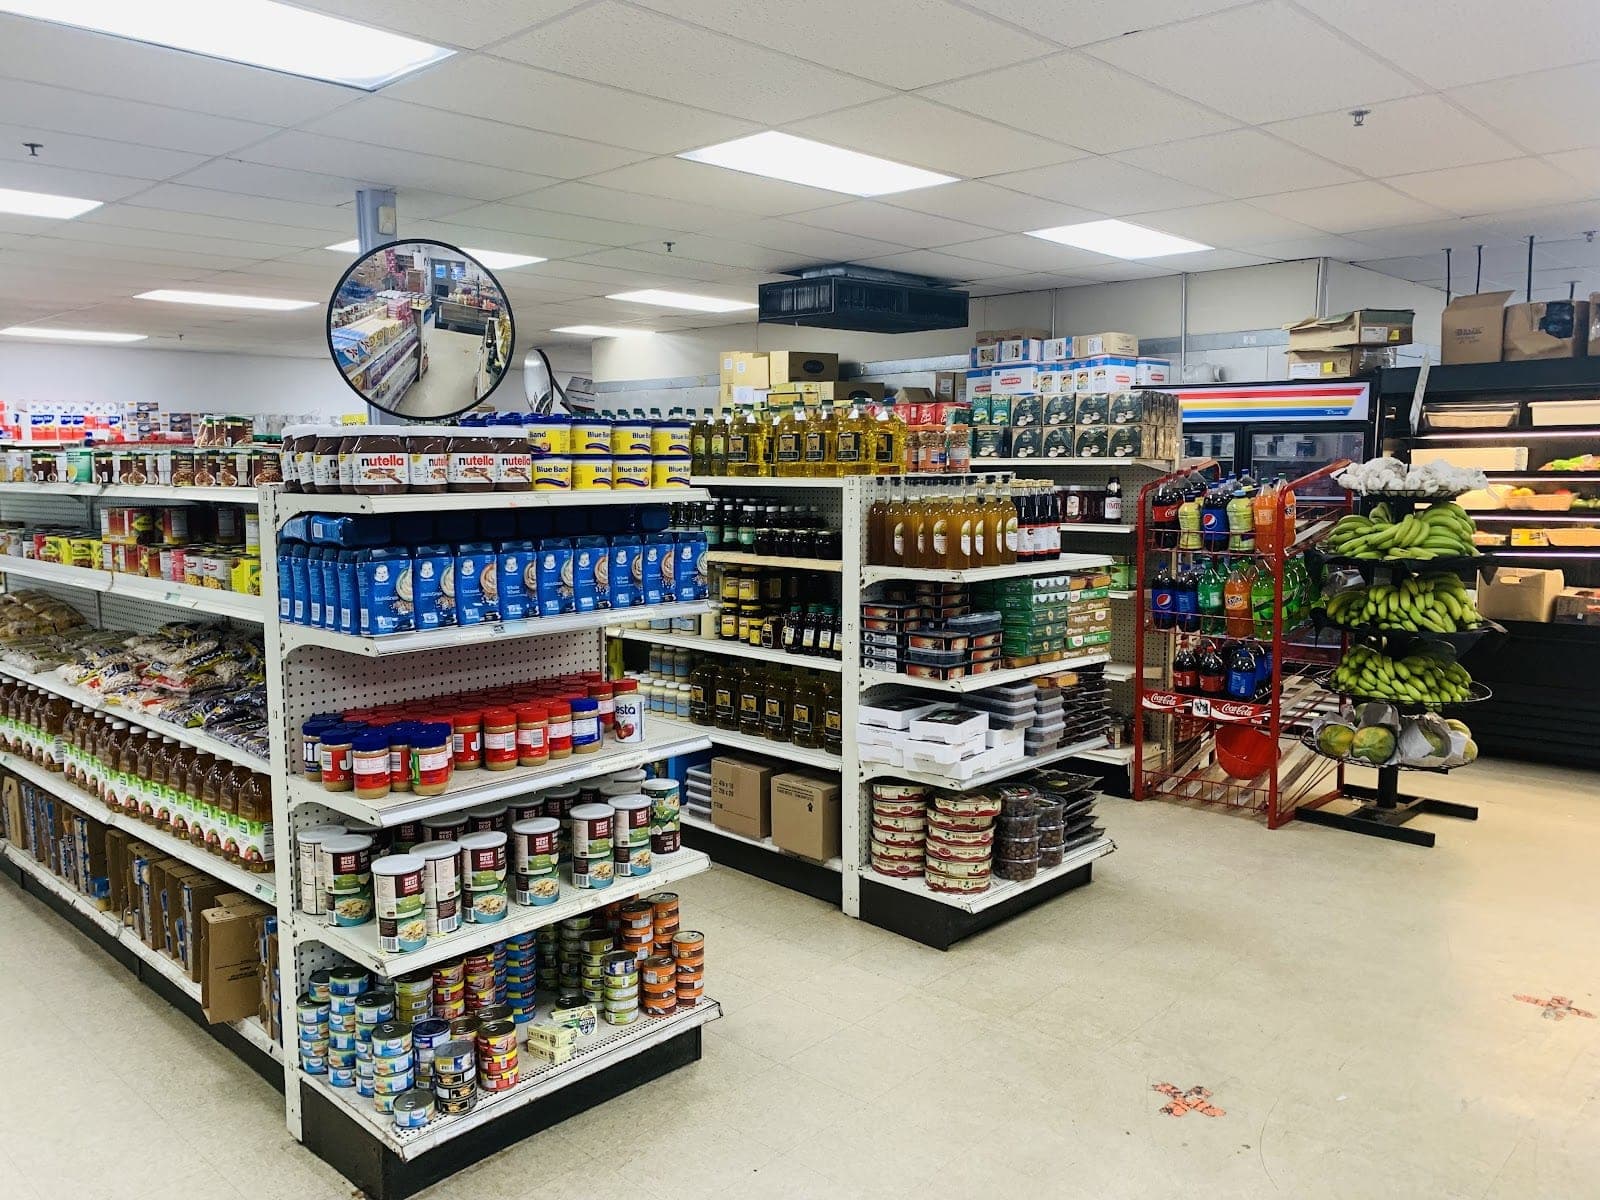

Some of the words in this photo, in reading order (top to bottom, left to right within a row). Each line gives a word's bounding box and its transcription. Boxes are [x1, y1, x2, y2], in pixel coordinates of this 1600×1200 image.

[361, 455, 404, 466] nutella
[459, 456, 494, 466] nutella
[502, 457, 531, 466] nutella
[537, 465, 553, 473] Blue
[1151, 693, 1177, 705] Coca-Cola
[616, 703, 636, 715] esta
[1222, 703, 1254, 716] Coca-Cola
